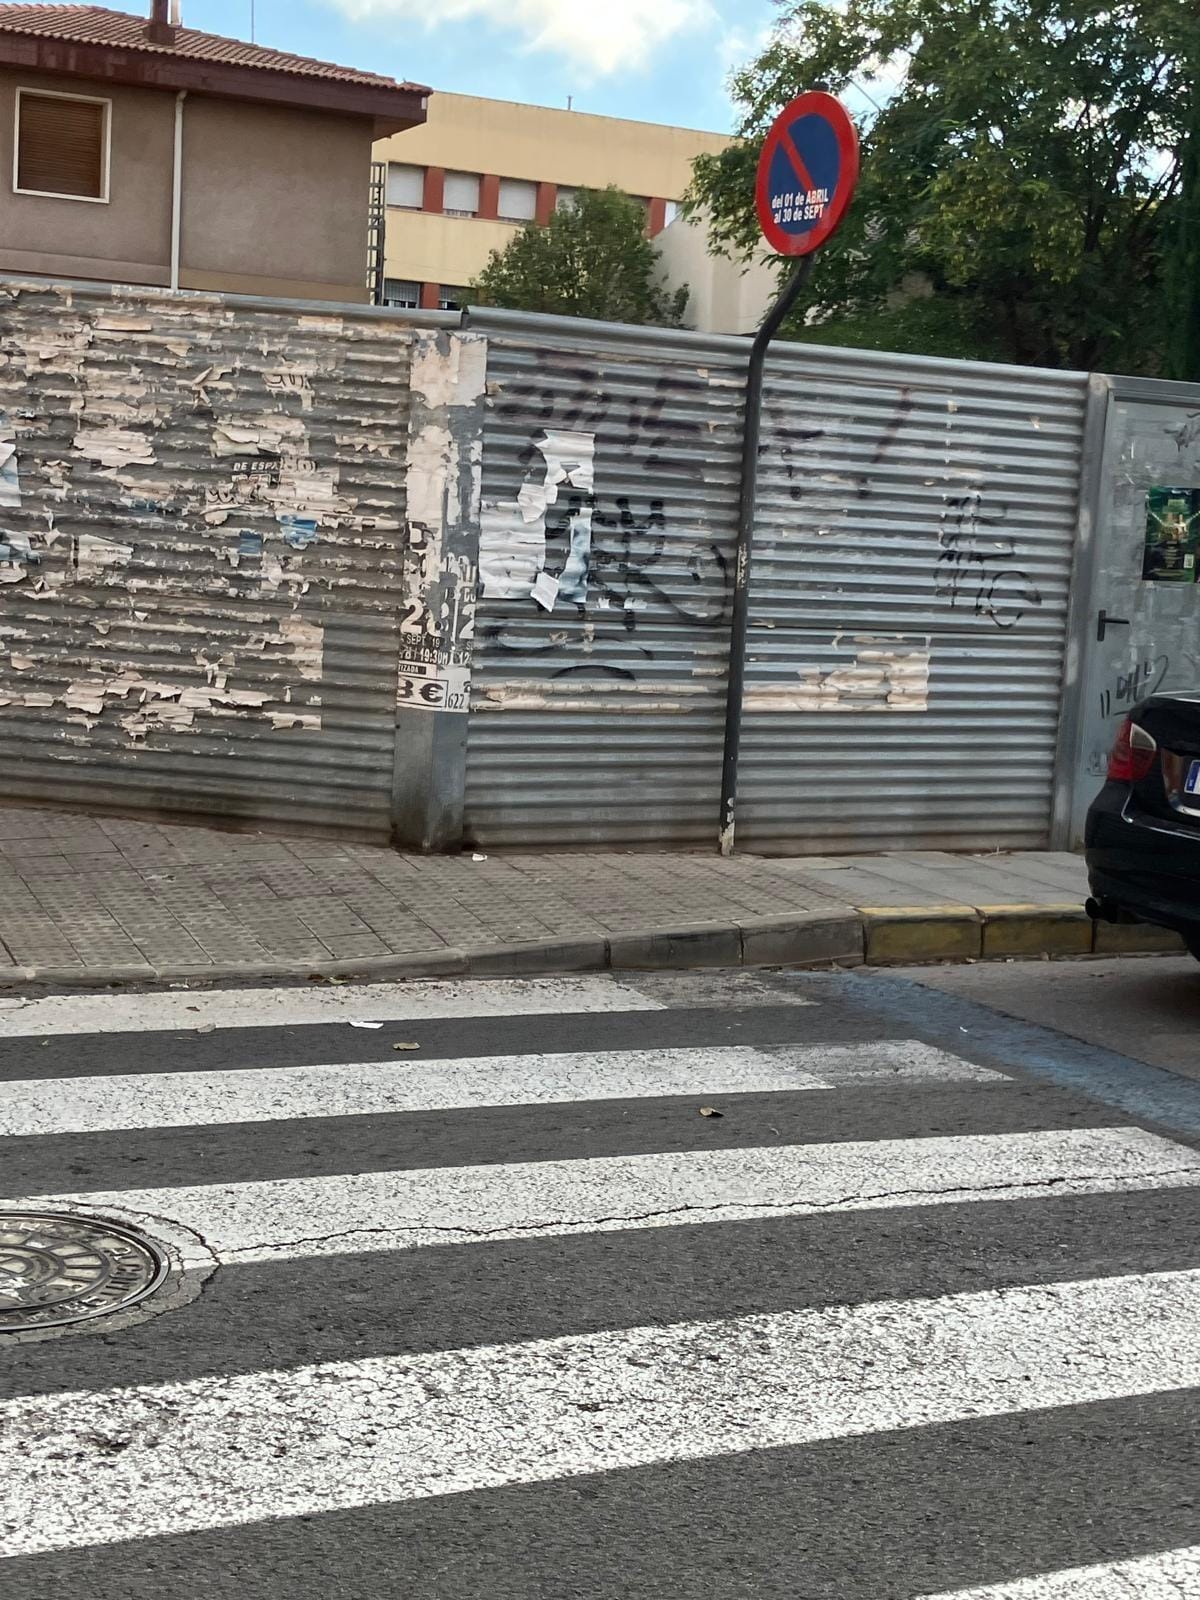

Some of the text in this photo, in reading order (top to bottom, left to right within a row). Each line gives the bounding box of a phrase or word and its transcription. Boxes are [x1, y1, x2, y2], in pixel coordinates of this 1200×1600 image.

[772, 188, 829, 209] del 01 de ABRIL
[773, 203, 825, 224] al 30 de SEPT
[233, 462, 248, 471] DE
[448, 693, 465, 709] 622
